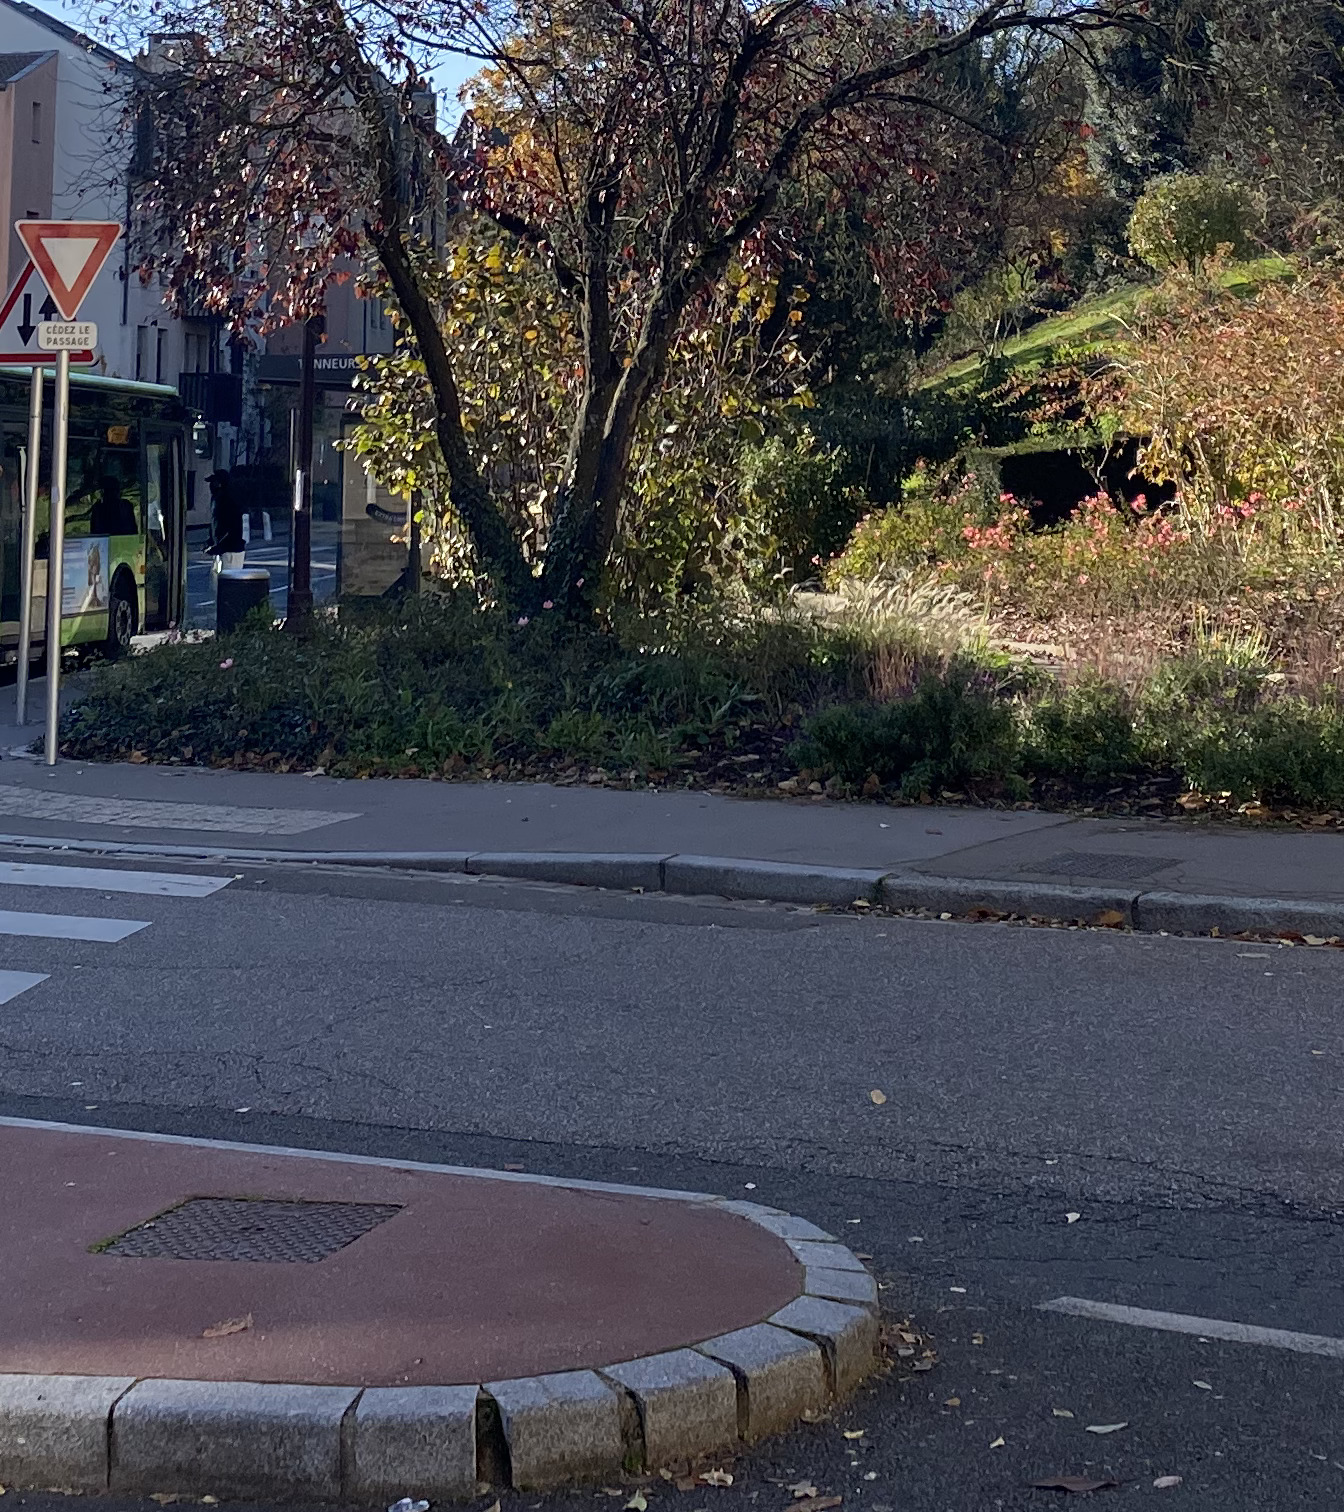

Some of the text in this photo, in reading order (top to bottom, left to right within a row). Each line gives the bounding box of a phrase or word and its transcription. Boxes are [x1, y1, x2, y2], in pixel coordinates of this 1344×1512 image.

[46, 324, 90, 335] CÉDEZ LE
[46, 337, 89, 346] PASSAGE
[297, 357, 362, 369] TNNEUR
